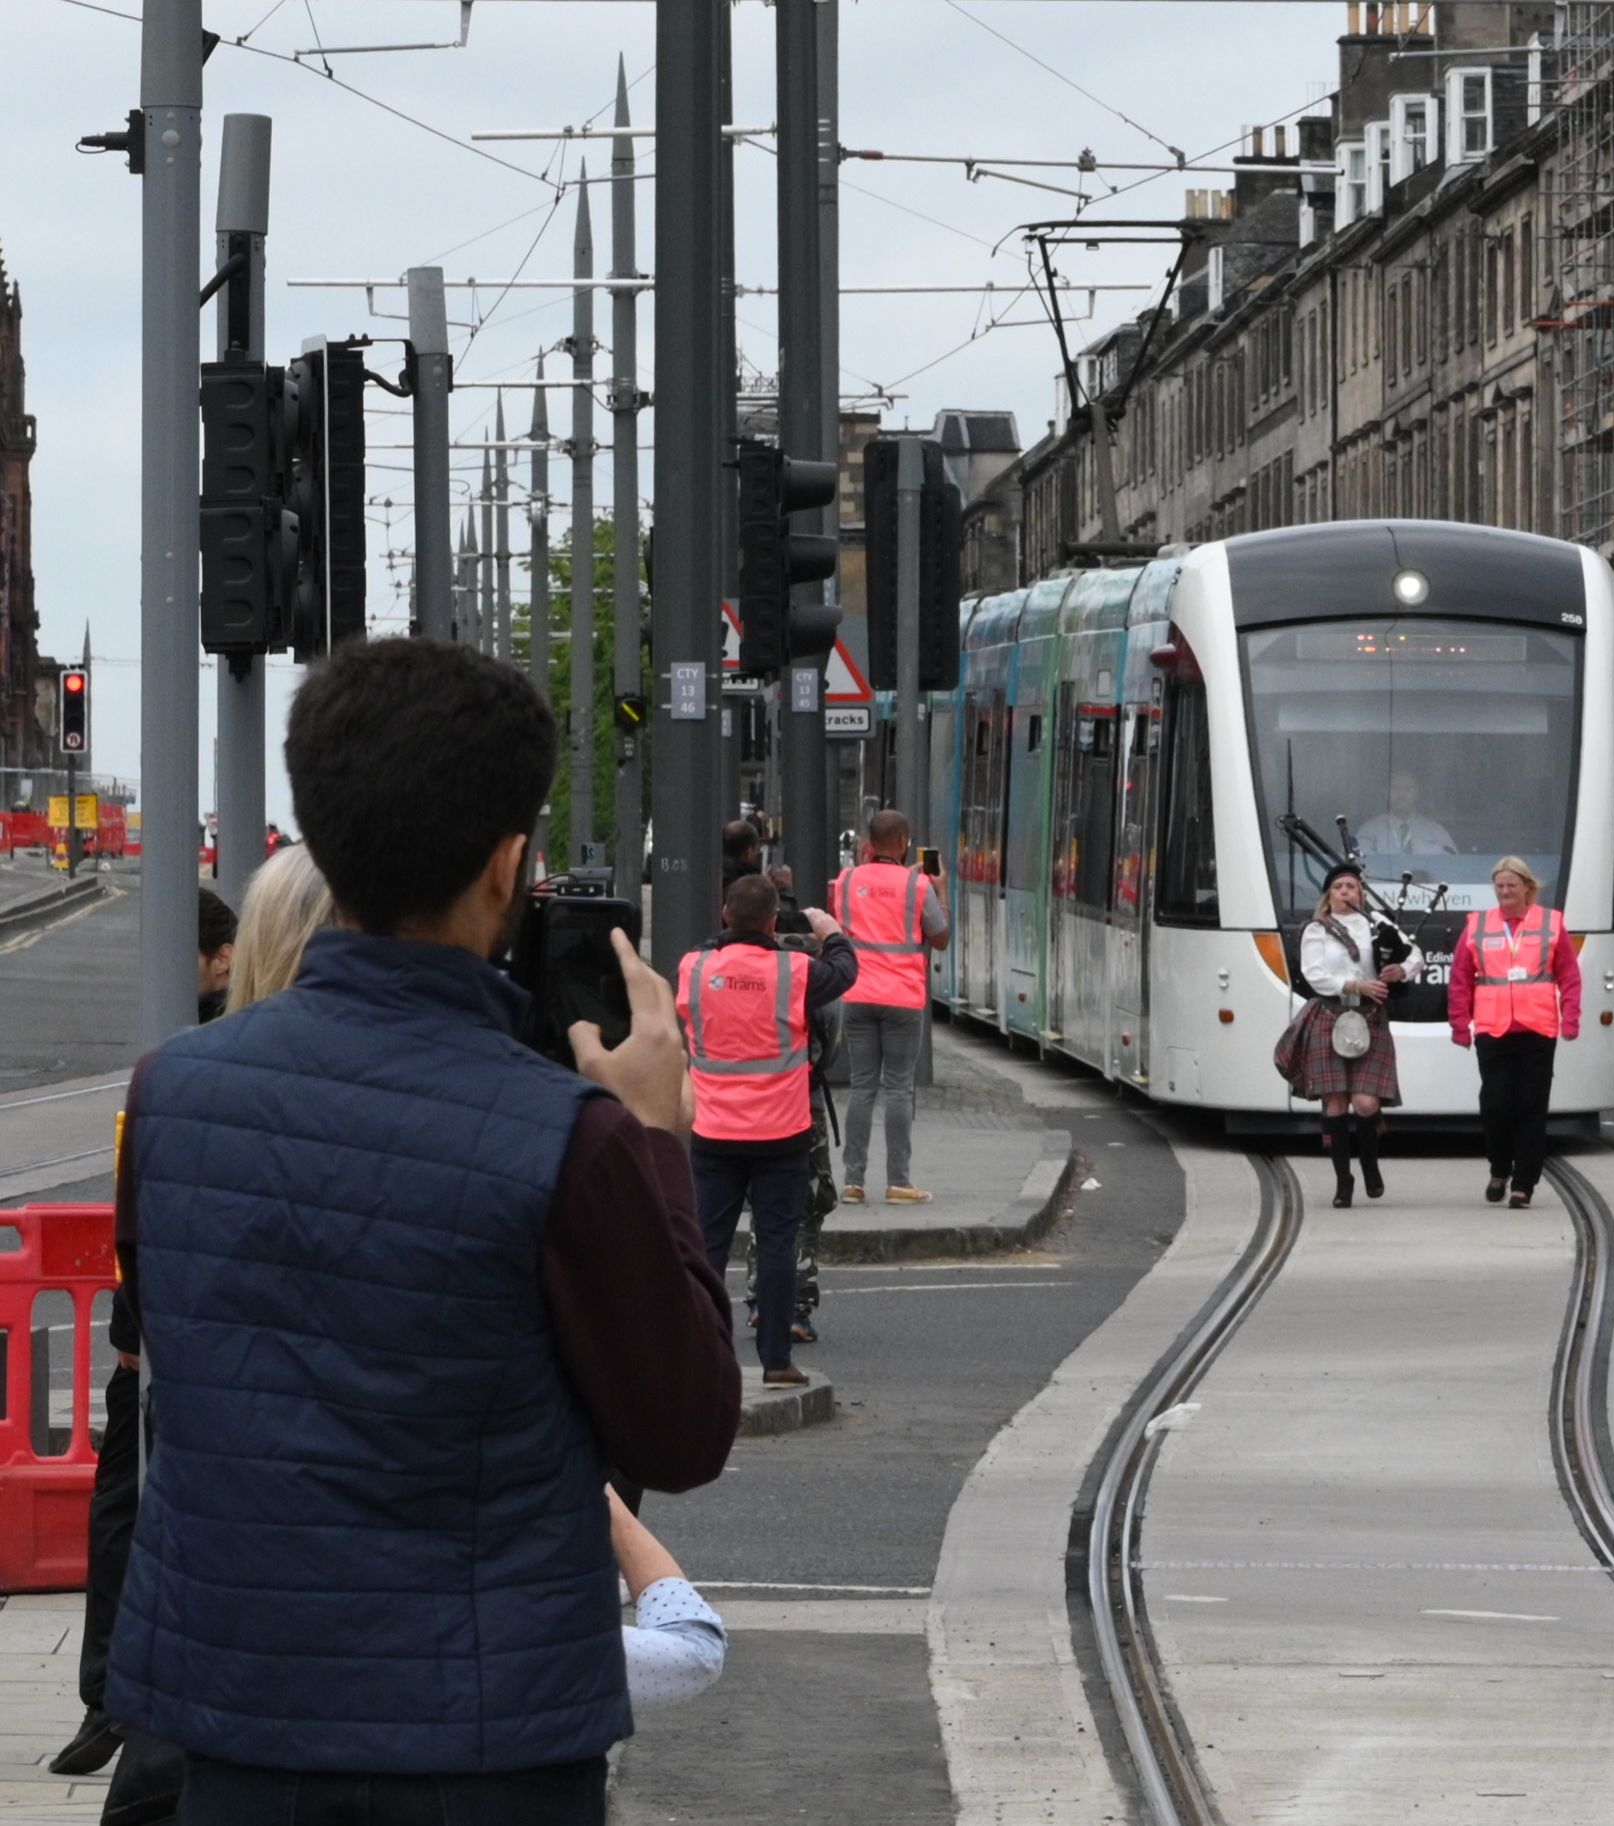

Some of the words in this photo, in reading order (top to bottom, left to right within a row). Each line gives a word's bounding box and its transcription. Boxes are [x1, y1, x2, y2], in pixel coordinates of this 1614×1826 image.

[676, 668, 699, 680] CTY
[795, 672, 812, 682] CTY
[681, 686, 696, 697] 13
[799, 686, 810, 695] 13
[680, 702, 696, 714] 46
[1383, 889, 1472, 906] Nwhven
[726, 976, 767, 992] Trams
